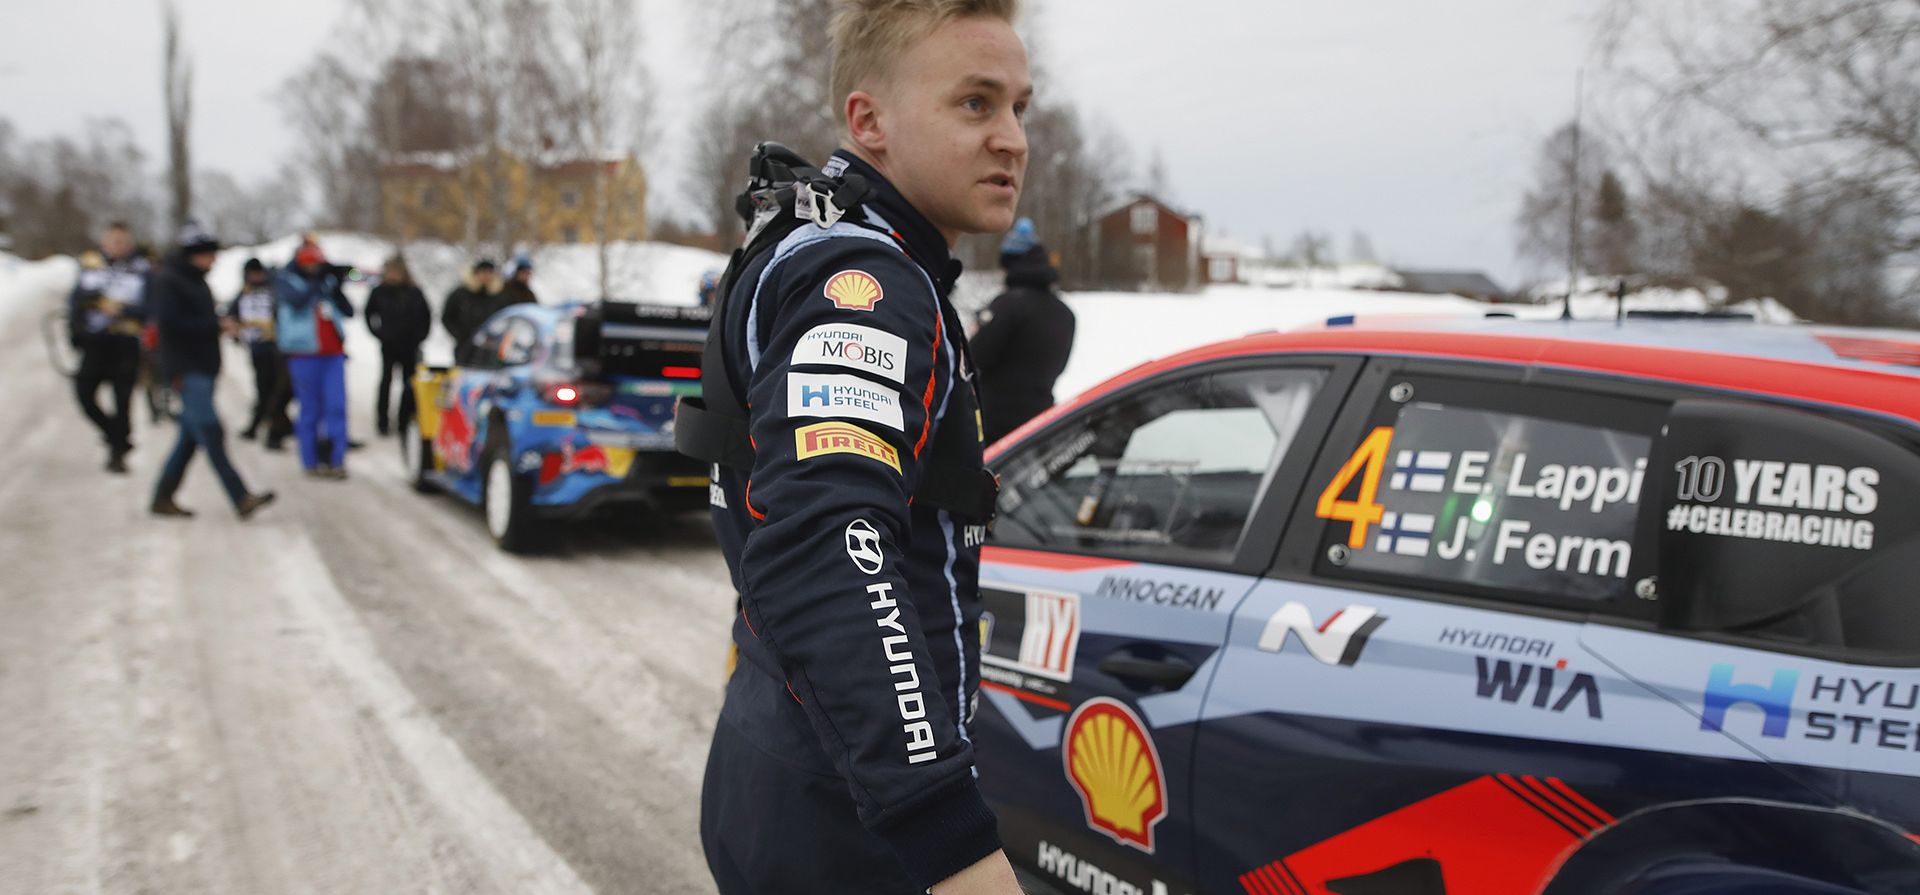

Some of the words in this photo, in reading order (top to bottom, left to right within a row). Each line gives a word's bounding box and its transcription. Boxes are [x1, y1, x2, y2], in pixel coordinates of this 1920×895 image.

[806, 330, 864, 342] HYUNDAI
[821, 340, 895, 371] MOBIS
[833, 386, 892, 406] HYUNDAI
[833, 396, 879, 411] STEEL
[804, 427, 897, 465] PIRELLI
[1315, 425, 1394, 550] 4
[1452, 450, 1493, 494] E.
[1506, 453, 1649, 513] Lappi
[1674, 455, 1726, 502] 10
[1732, 458, 1880, 515] YEARS
[1436, 515, 1477, 562] J.
[1492, 519, 1633, 578] Ferm
[1666, 503, 1875, 550] #CELEBRACING
[1096, 575, 1225, 611] INNOCEAN
[1438, 626, 1555, 659] HYUNDAI
[866, 582, 937, 765] HYUNDAI
[1804, 711, 1920, 752] STE
[1037, 840, 1145, 895] HYUNDA
